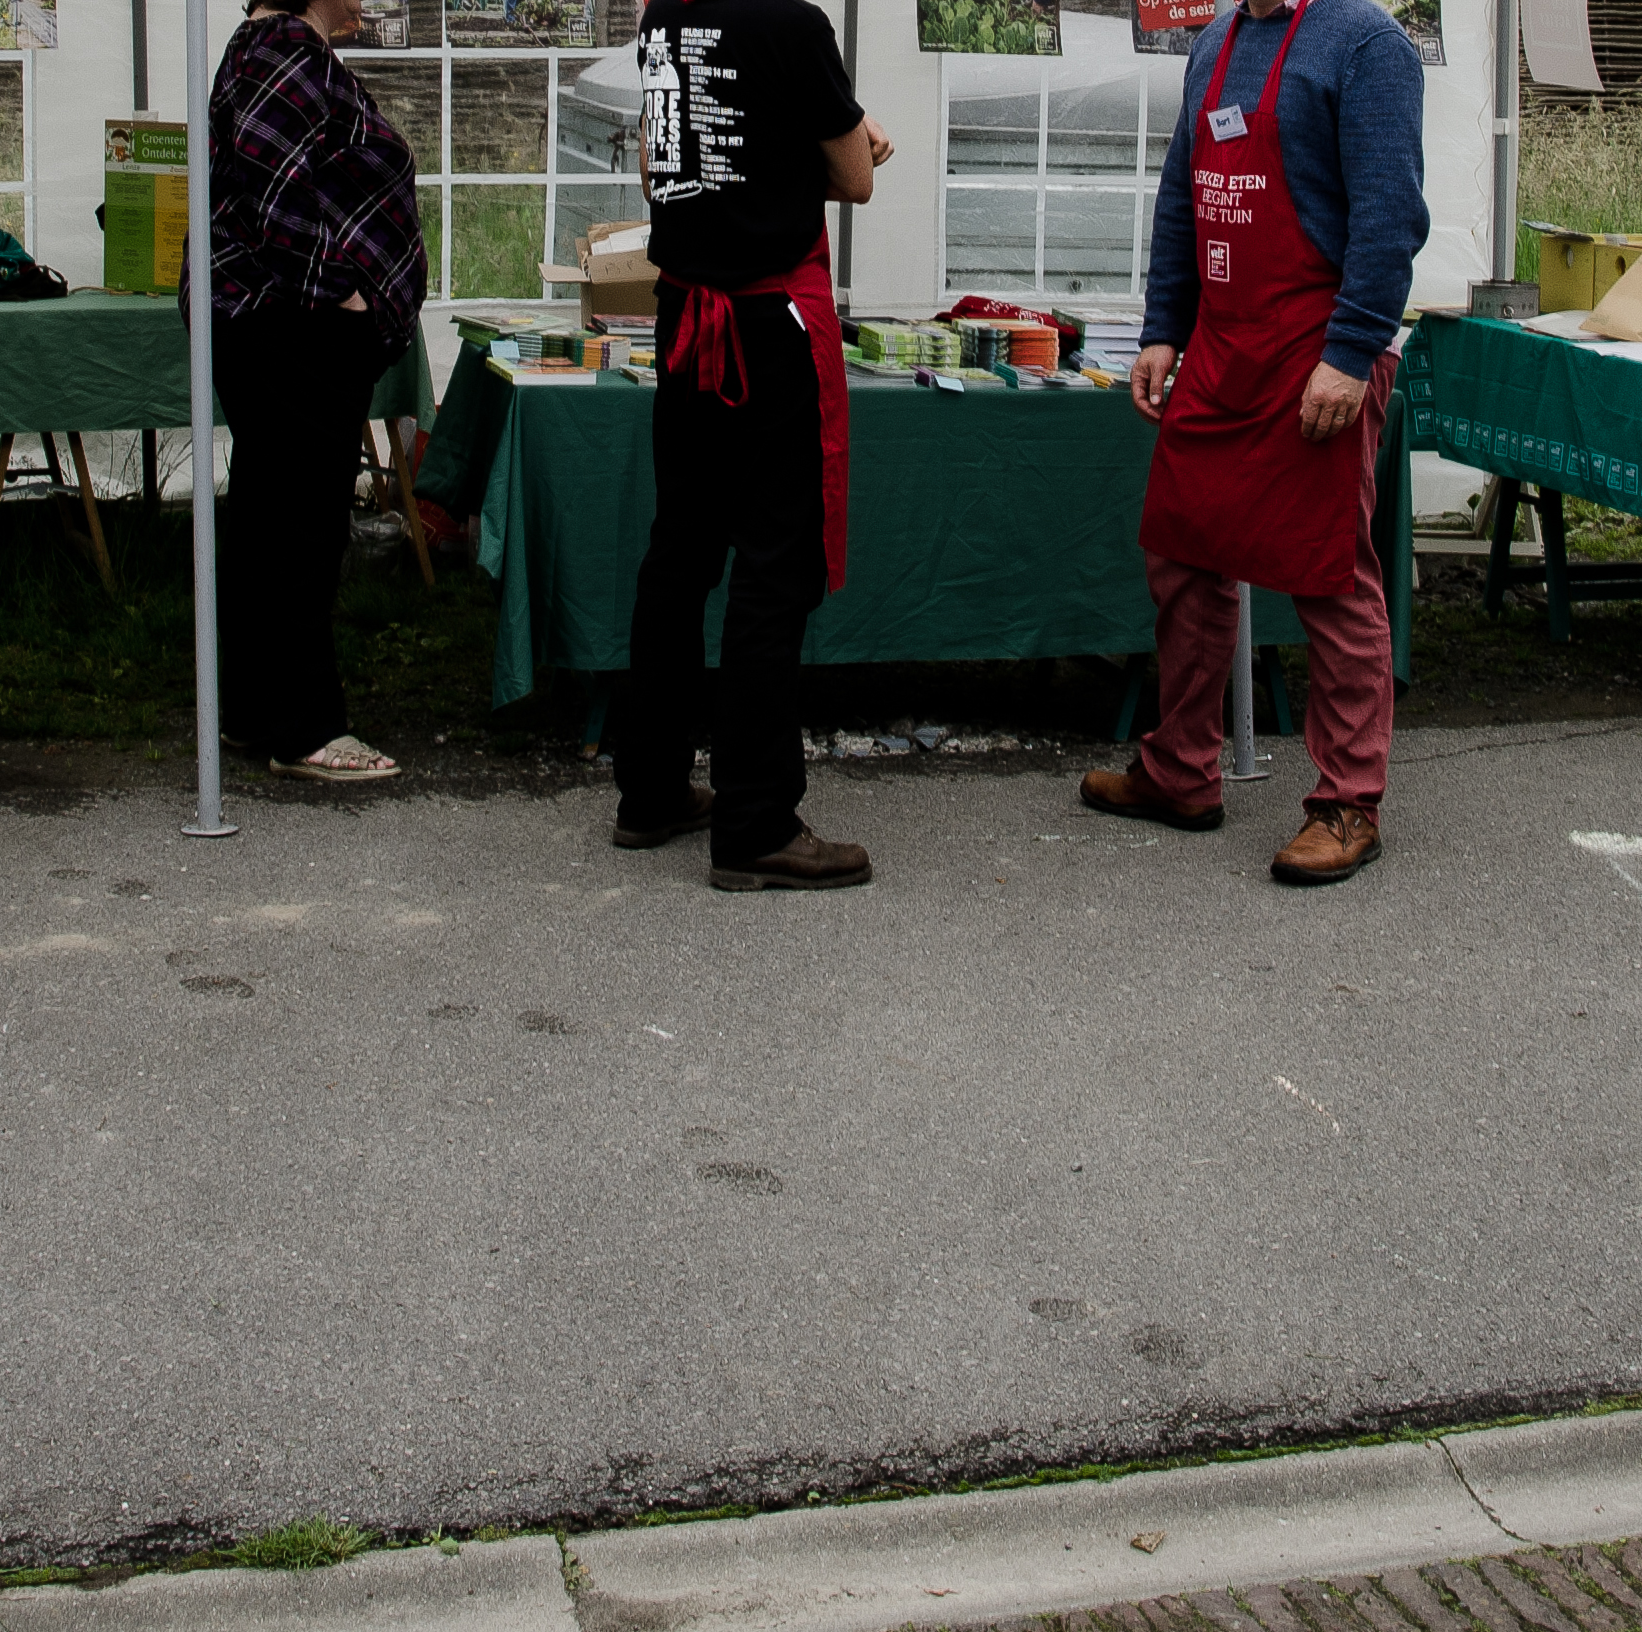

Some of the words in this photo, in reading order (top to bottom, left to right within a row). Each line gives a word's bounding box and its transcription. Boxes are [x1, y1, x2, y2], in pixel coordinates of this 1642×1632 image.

[1169, 5, 1186, 20] de
[1189, 1, 1216, 17] seiz
[645, 90, 681, 119] ORE
[142, 133, 186, 146] Groenten
[142, 147, 176, 160] Ontdek
[1195, 169, 1224, 189] LEKKER
[1228, 175, 1266, 190] ETEN
[1202, 188, 1242, 207] BEGINT
[1206, 207, 1217, 222] JE
[1219, 209, 1252, 224] TUIN
